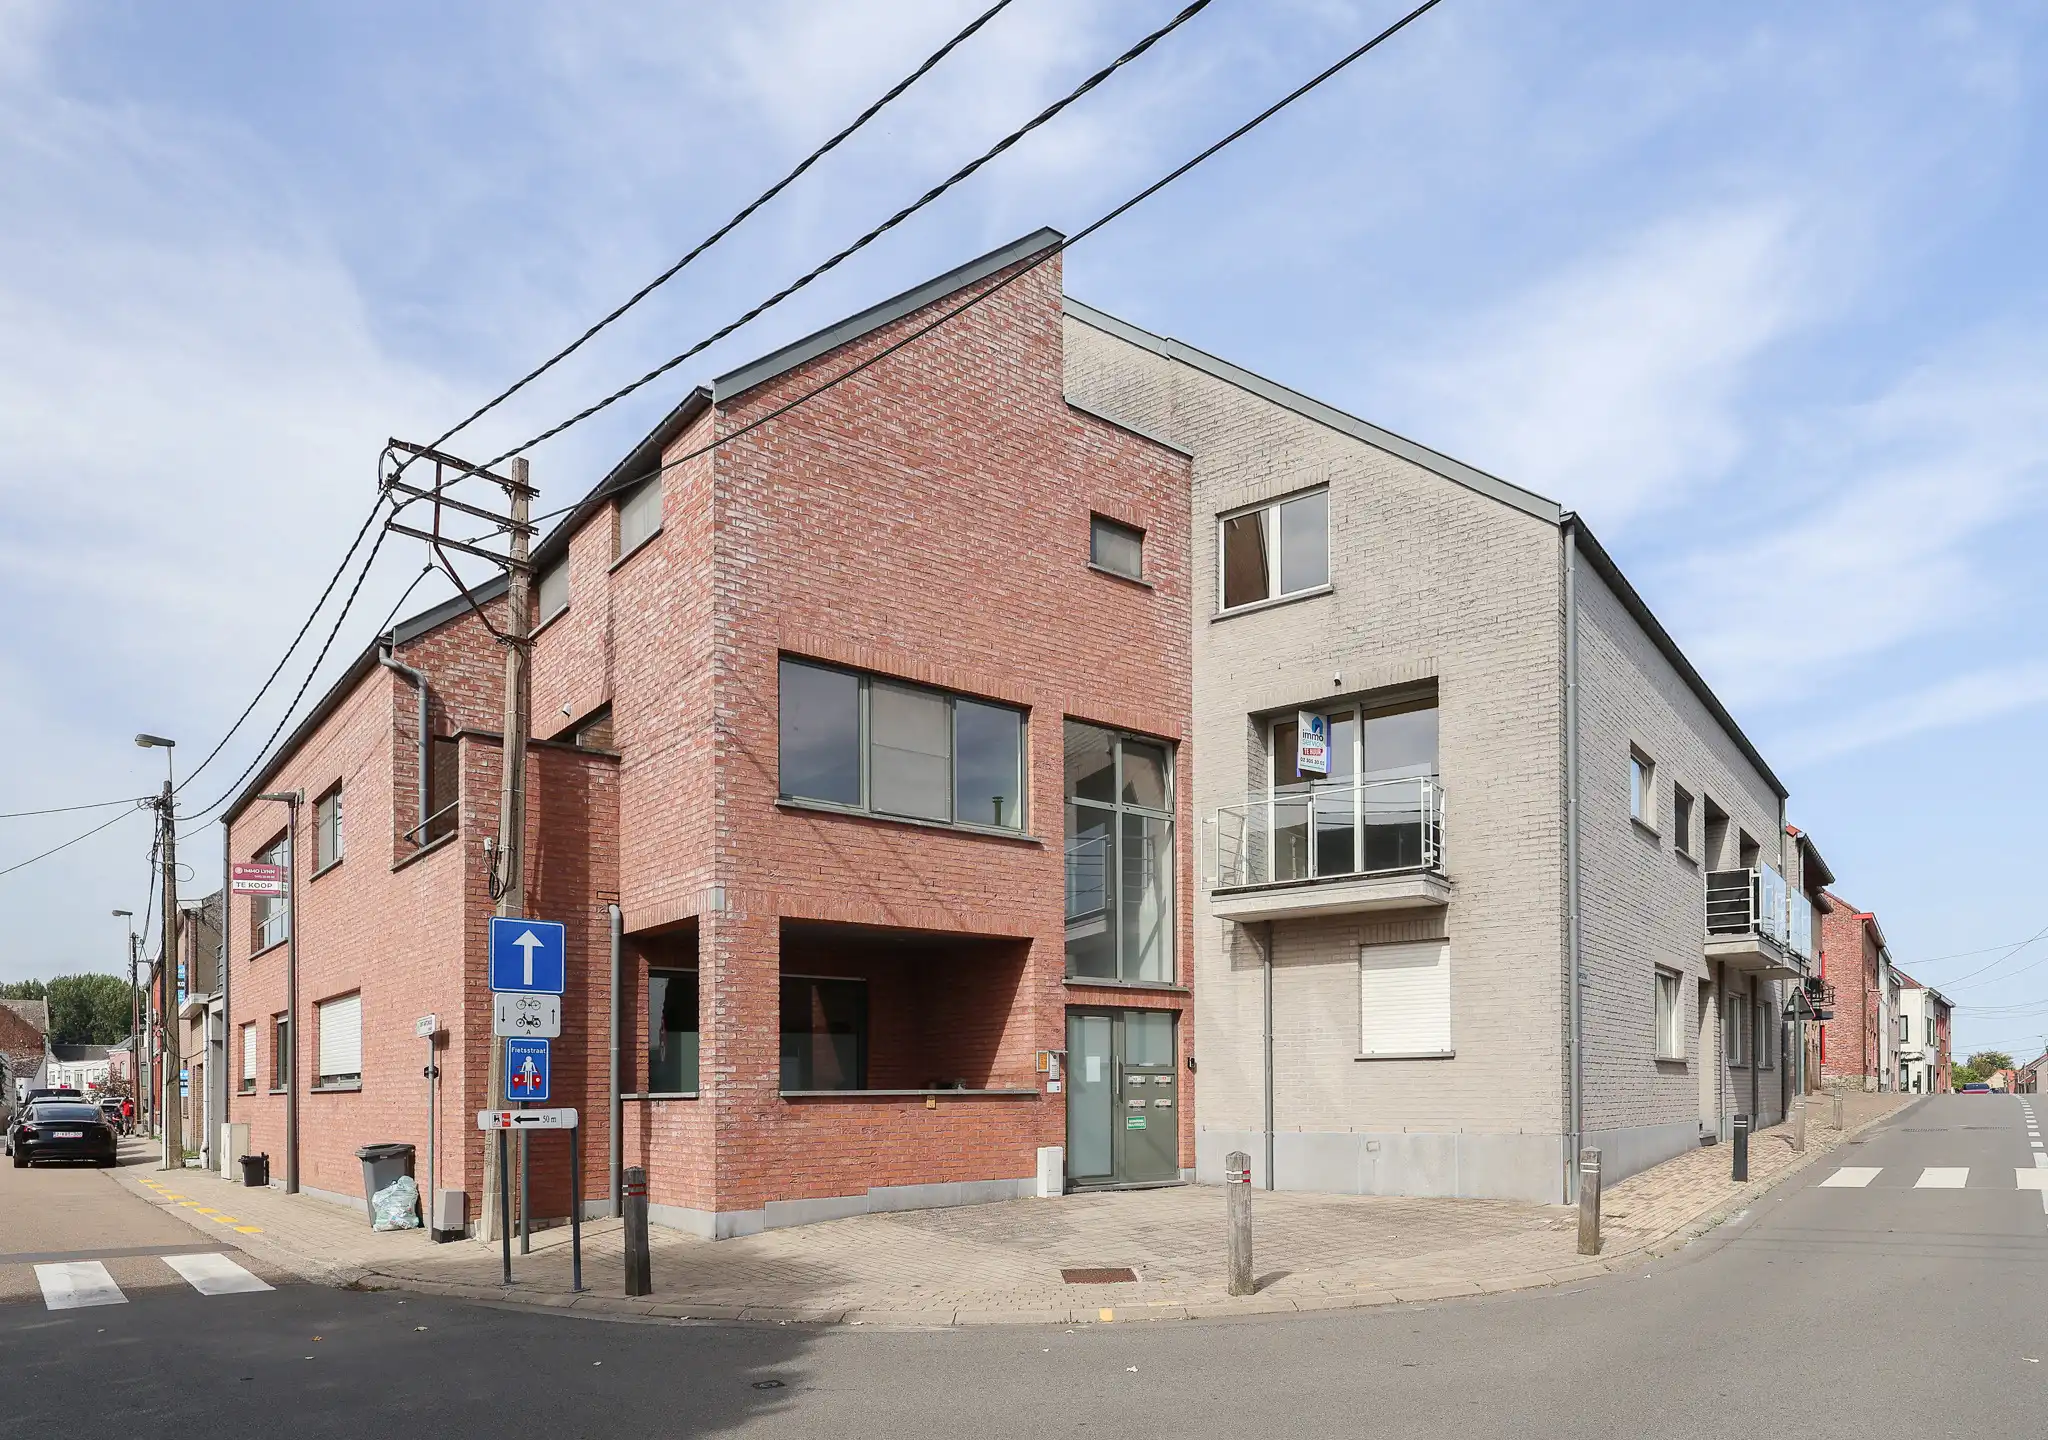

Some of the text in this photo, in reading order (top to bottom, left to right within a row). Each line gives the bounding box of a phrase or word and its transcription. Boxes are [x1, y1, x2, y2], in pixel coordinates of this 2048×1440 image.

[1302, 729, 1324, 742] immo
[511, 1046, 546, 1054] Fietsstraat
[542, 1115, 550, 1123] 50
